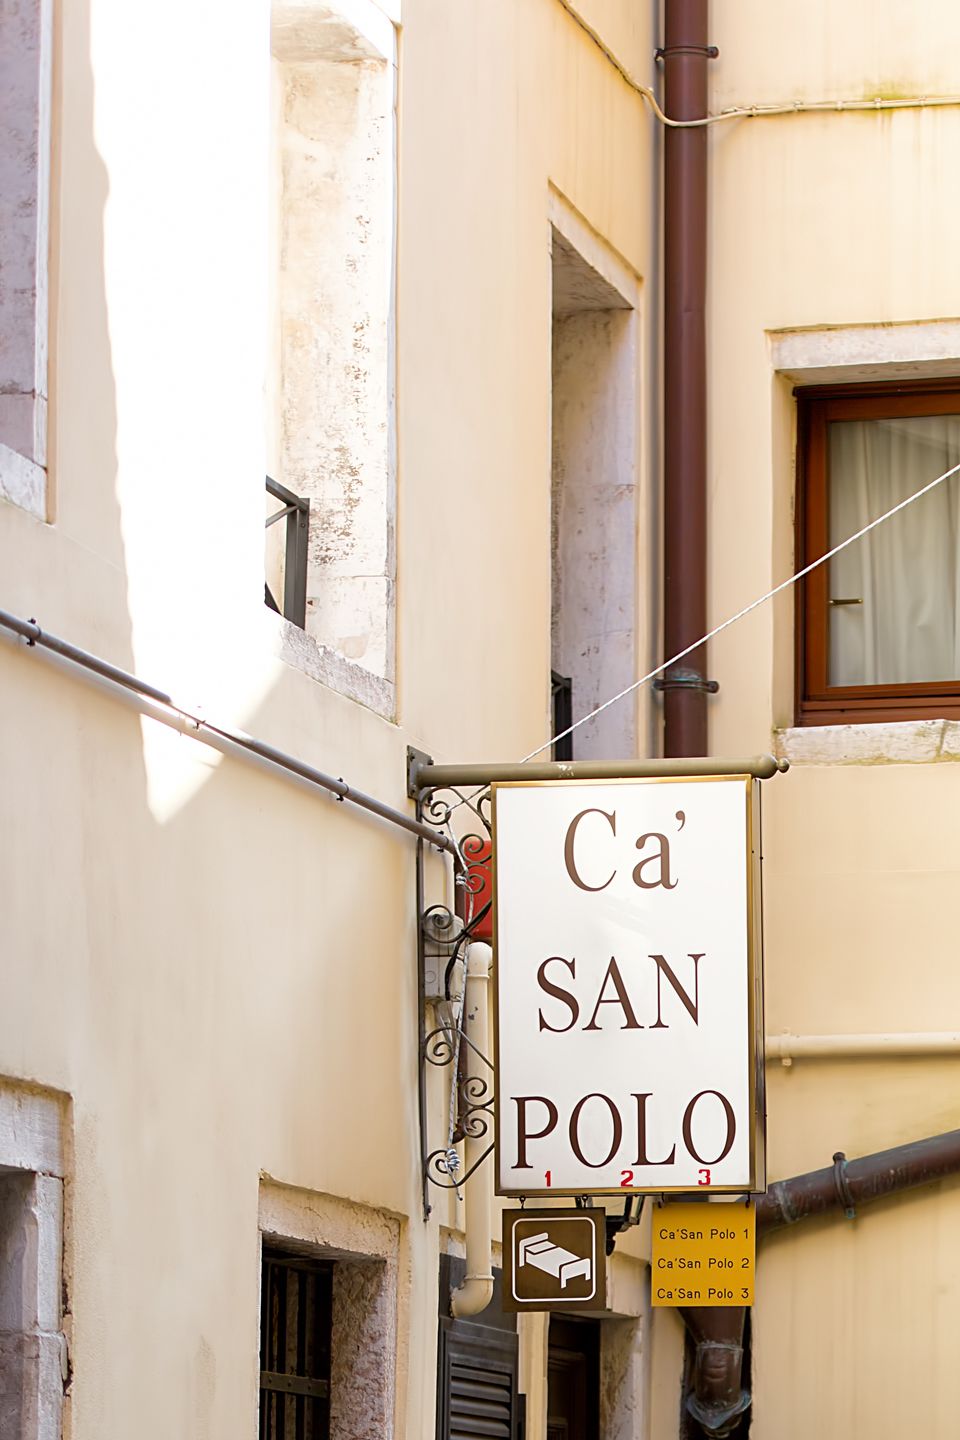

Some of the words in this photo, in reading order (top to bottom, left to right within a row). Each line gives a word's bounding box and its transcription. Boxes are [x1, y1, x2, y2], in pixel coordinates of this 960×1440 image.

[564, 808, 686, 892] Ca'
[536, 953, 706, 1033] SAN
[509, 1089, 737, 1170] POLO
[543, 1169, 553, 1188] 1
[620, 1169, 634, 1188] 2
[697, 1168, 712, 1187] 3
[710, 1227, 736, 1240] Polo
[743, 1227, 749, 1240] 1
[708, 1257, 734, 1270] Polo
[741, 1257, 750, 1270] 2
[707, 1287, 734, 1300] Polo
[740, 1287, 750, 1300] 3
